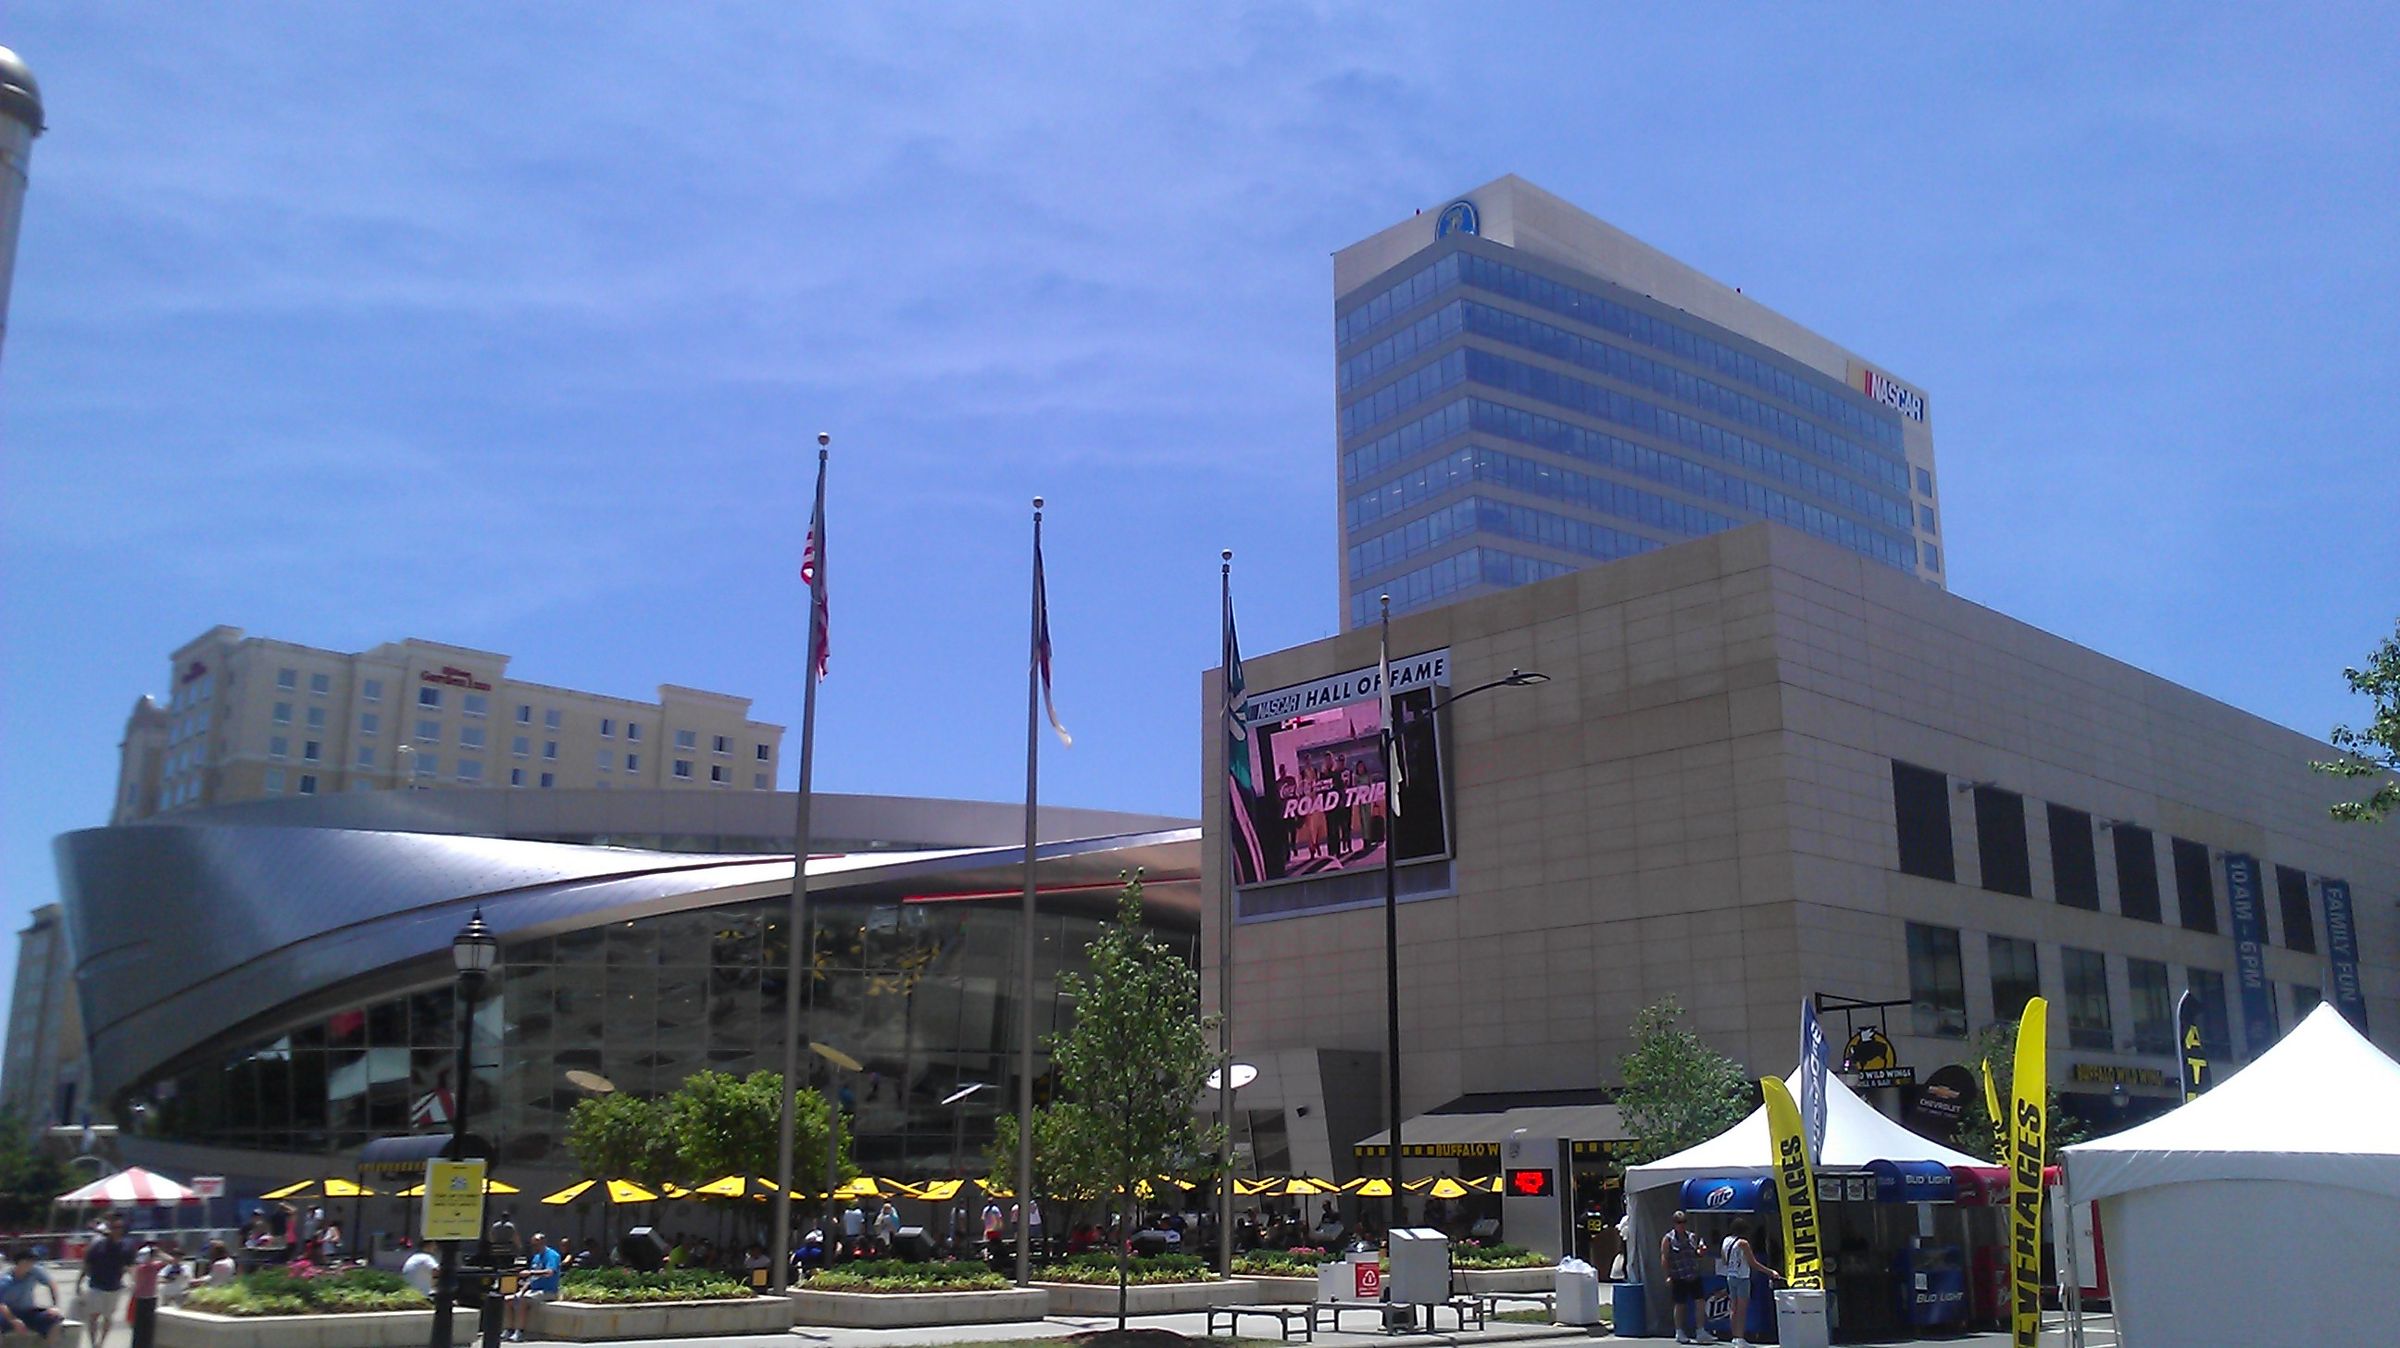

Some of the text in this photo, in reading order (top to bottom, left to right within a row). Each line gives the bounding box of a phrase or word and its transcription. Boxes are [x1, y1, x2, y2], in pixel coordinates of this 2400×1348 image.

[1867, 371, 1923, 423] NASCAR
[1251, 658, 1444, 720] NASCAR HALL OF FAME
[1284, 791, 1340, 818] ROAD
[2327, 888, 2358, 1001] FAMILY FUN
[1919, 1098, 1962, 1113] CHEVROLET
[1436, 1143, 1485, 1157] BUFFALO
[1906, 1174, 1925, 1185] BUD
[1928, 1175, 1951, 1185] LIGHT
[2016, 1098, 2042, 1348] EVERAGES
[1917, 1292, 1964, 1303] BUD LIGHT
